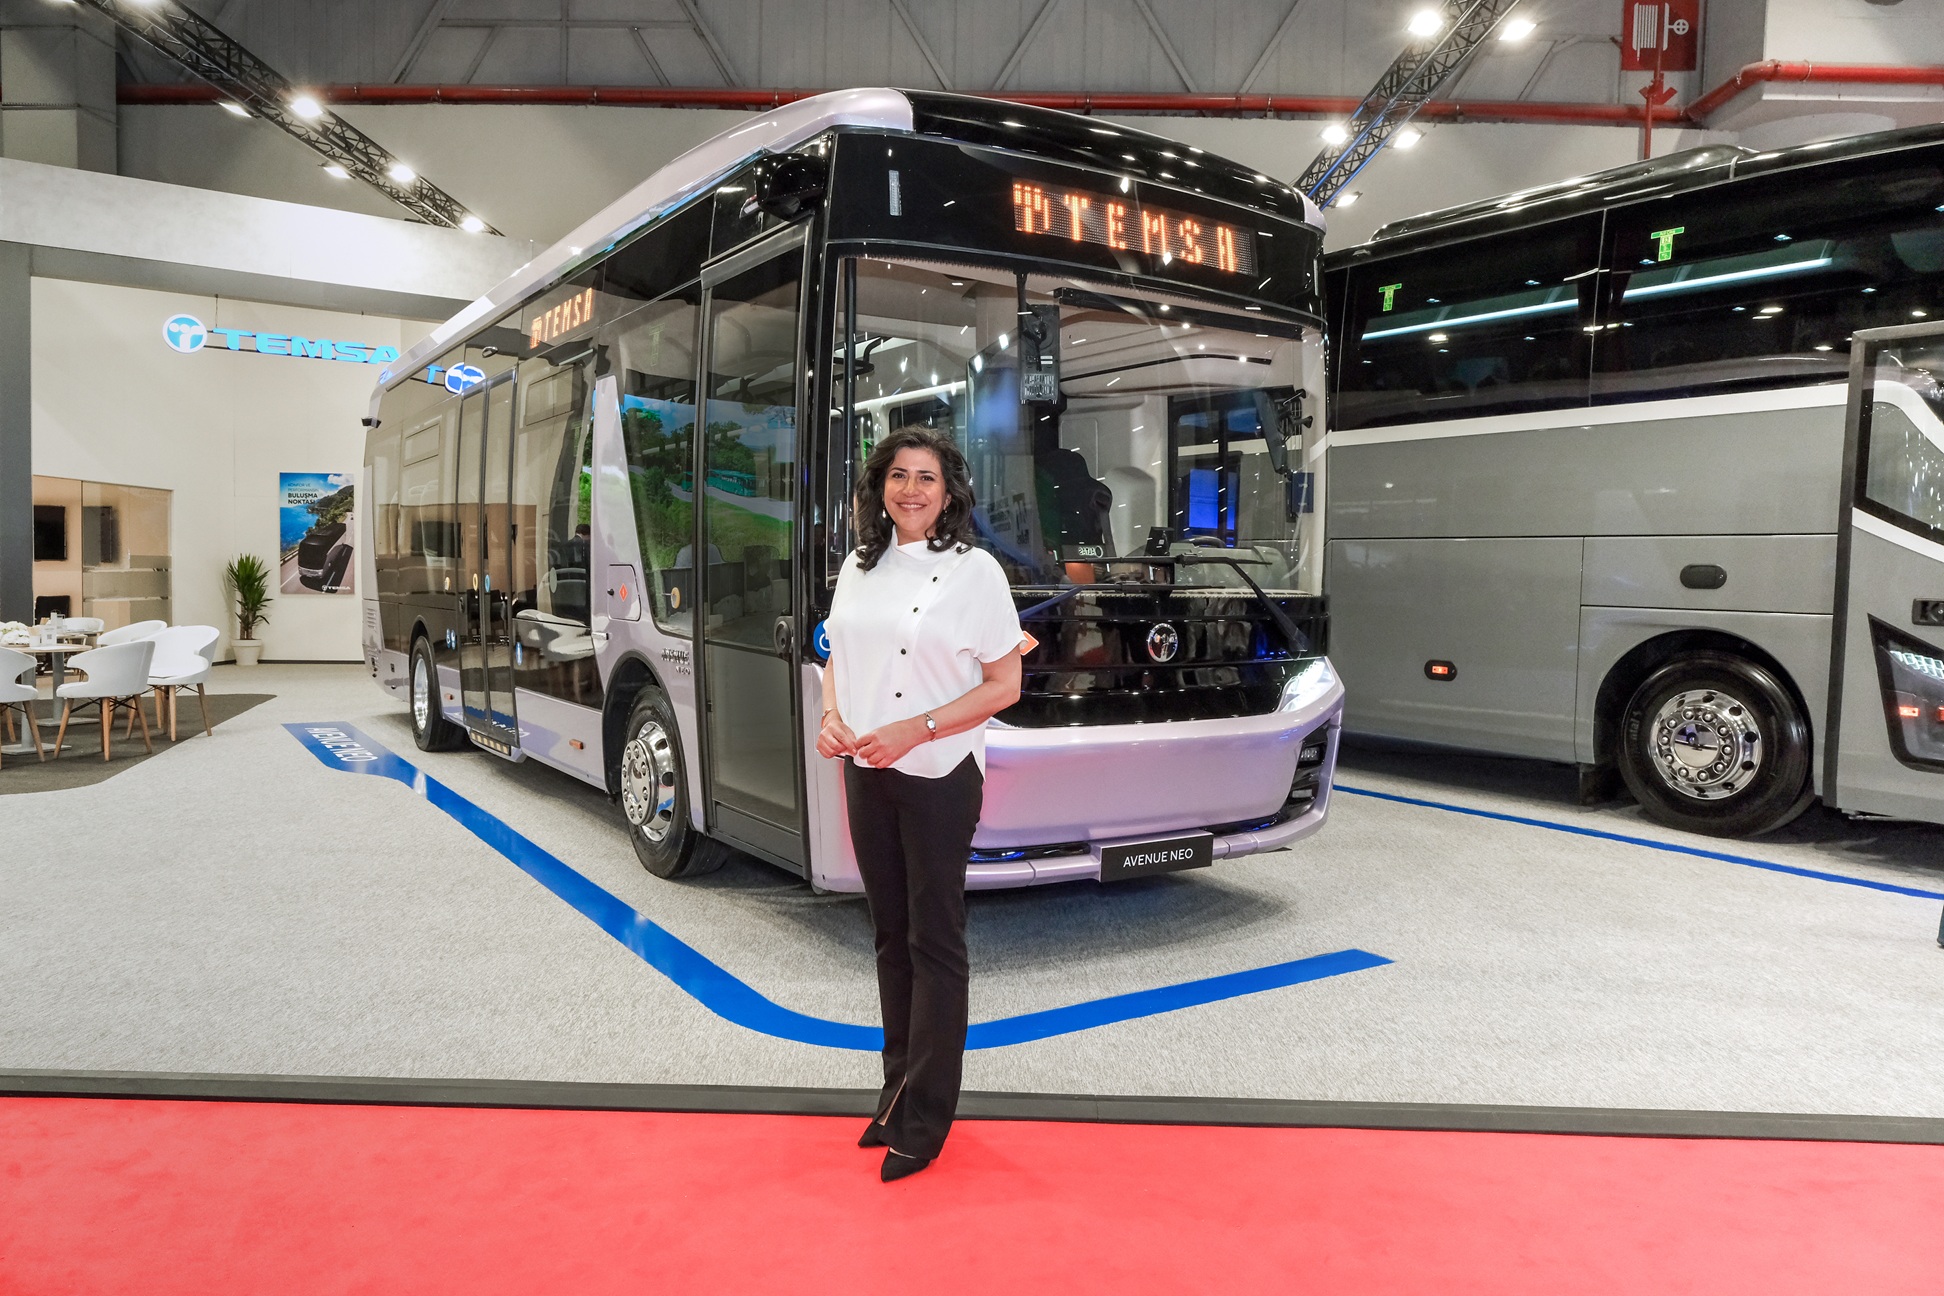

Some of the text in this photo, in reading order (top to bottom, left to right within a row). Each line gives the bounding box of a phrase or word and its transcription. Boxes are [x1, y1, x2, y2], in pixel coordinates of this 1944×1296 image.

[1064, 194, 1236, 272] TEMSA
[544, 287, 593, 342] TEMSA
[213, 327, 400, 364] TEMSA
[676, 666, 691, 675] NEO
[304, 727, 379, 762] AVENUE NEO
[1123, 848, 1194, 868] AVENUE NEO
